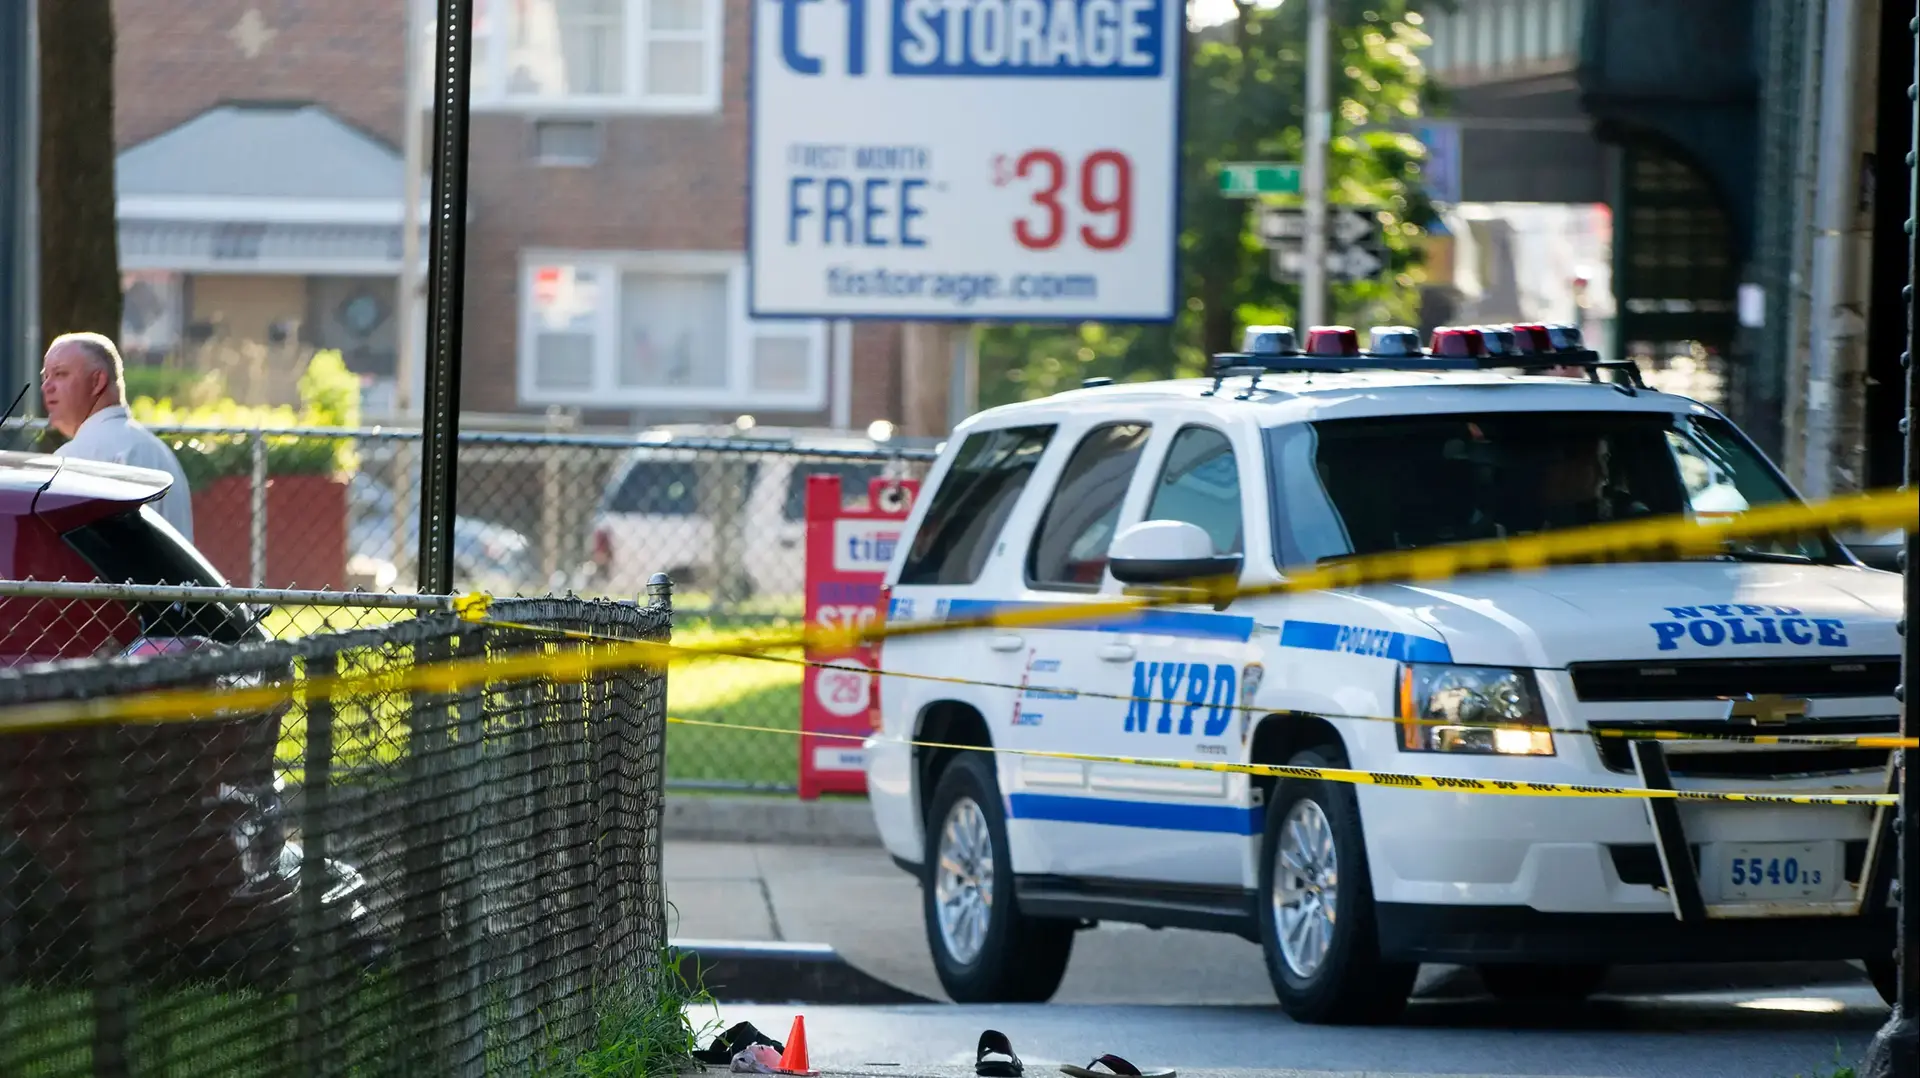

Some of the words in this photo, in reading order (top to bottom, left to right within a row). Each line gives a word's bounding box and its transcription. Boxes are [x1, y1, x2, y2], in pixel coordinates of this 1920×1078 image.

[899, 0, 1154, 67] STORAGE
[788, 177, 929, 246] FREE
[827, 266, 1098, 304] tistorage.com
[1664, 604, 1803, 618] NYPD
[1335, 626, 1393, 659] POLICE
[1650, 618, 1849, 650] POLICE
[1124, 661, 1236, 736] NYPD
[1731, 857, 1798, 885] 5540
[1801, 870, 1821, 885] 13
